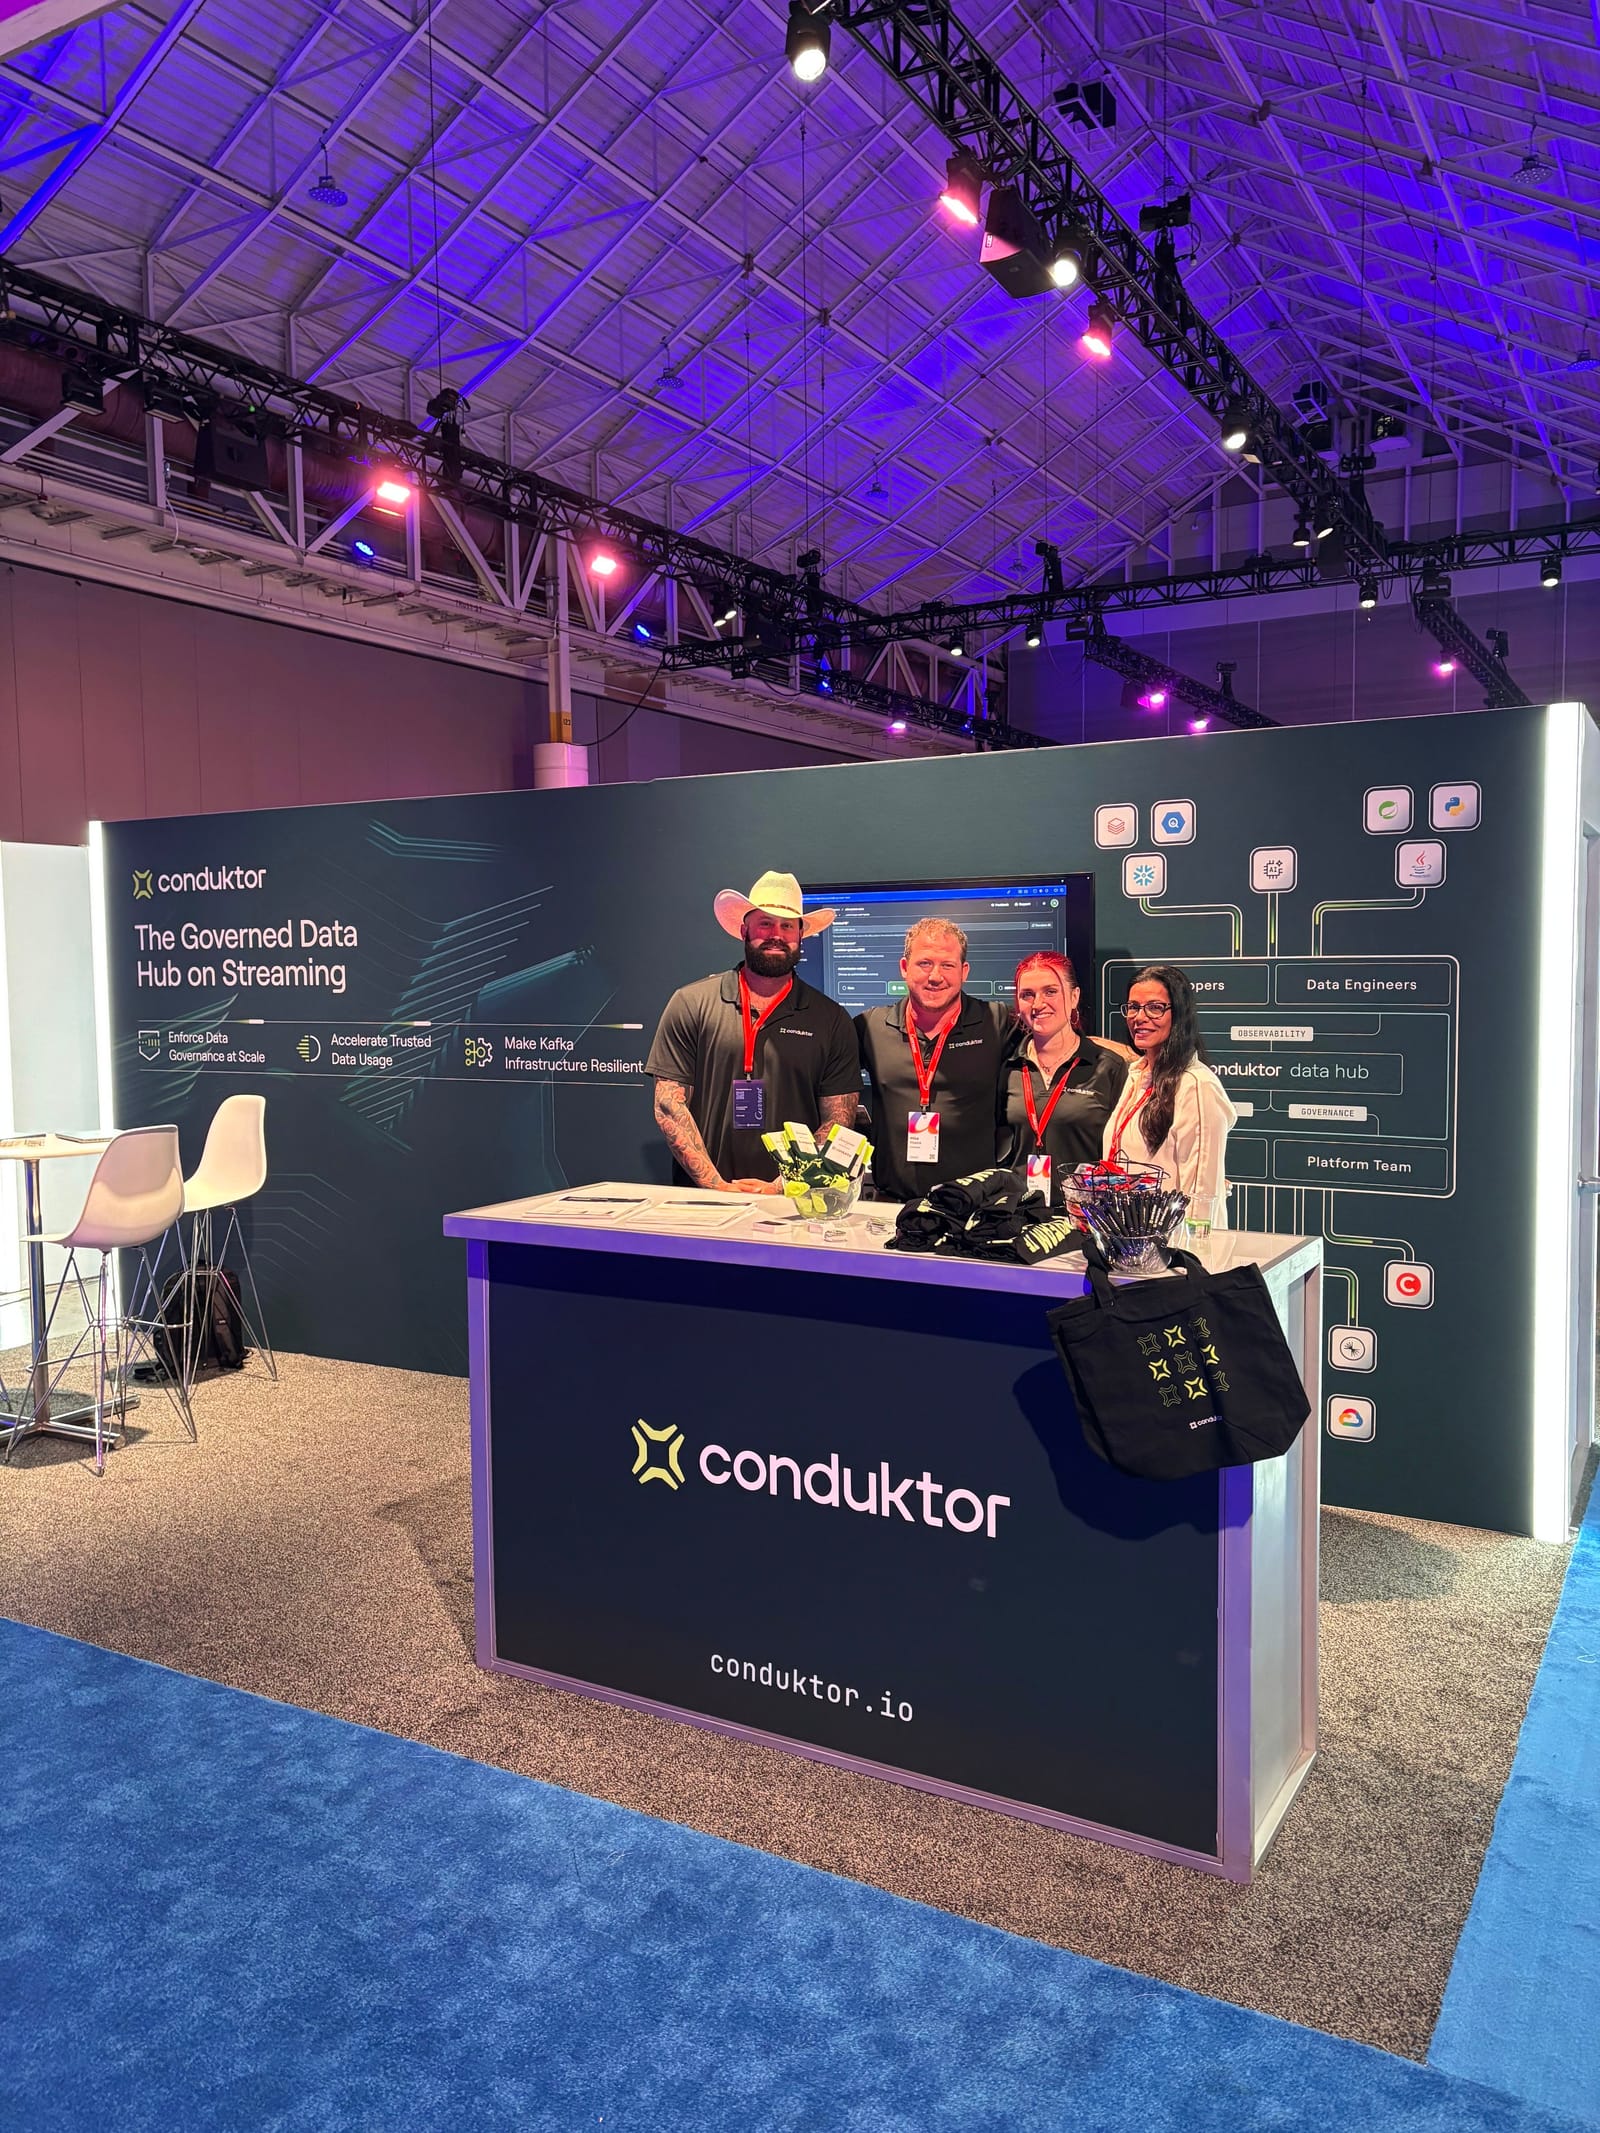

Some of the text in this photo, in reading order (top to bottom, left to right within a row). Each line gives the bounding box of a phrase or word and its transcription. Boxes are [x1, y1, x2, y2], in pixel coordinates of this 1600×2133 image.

[158, 865, 267, 893] conduktor
[134, 919, 358, 951] The Governed Data
[137, 957, 347, 994] Hub on Streaming
[1306, 978, 1417, 993] Data Engineers
[168, 1031, 229, 1044] Enforce Data
[331, 1033, 432, 1048] Accelerate Trusted
[1238, 1029, 1306, 1038] OBSERVABILITY
[504, 1036, 574, 1051] Make Kafka
[168, 1049, 266, 1063] Governance at Scale
[331, 1052, 393, 1069] Data Usage
[505, 1056, 644, 1074] Infrastructure Resilient
[1210, 1062, 1369, 1079] onduktor data hub
[1301, 1107, 1355, 1118] GOVERNANCE
[1307, 1155, 1412, 1173] Platform Team
[699, 1444, 1011, 1538] conduktor
[710, 1653, 913, 1722] conduktor.io
